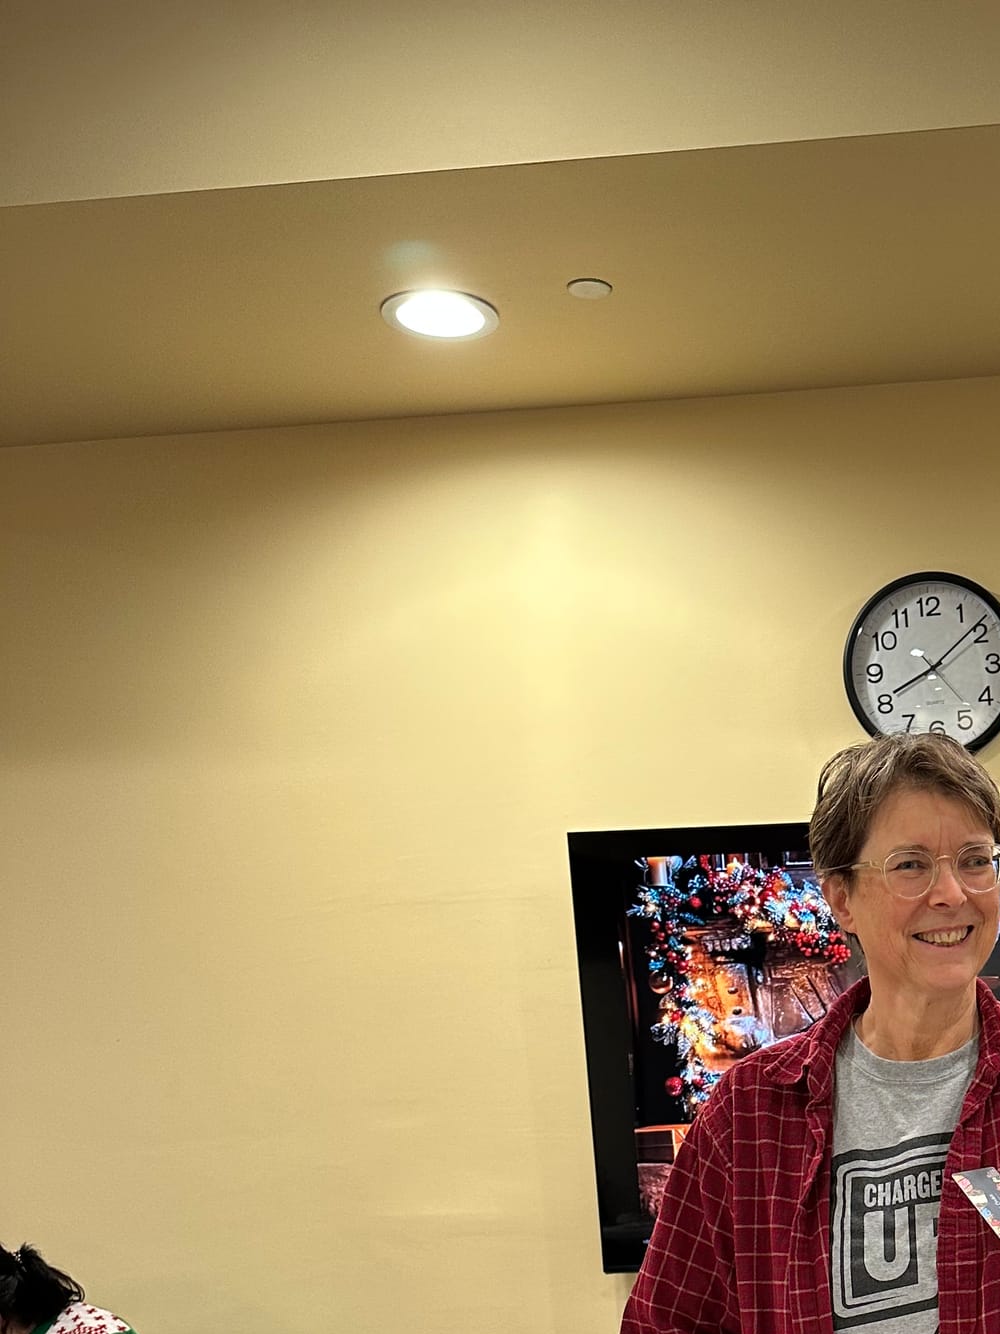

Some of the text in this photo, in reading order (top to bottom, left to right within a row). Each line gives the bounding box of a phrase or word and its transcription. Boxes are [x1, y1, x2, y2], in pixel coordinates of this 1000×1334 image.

[916, 596, 941, 617] 12
[956, 603, 964, 623] 1
[892, 607, 909, 629] 11
[872, 631, 898, 651] 10
[973, 623, 988, 644] 2
[866, 663, 883, 683] 9
[984, 653, 1000, 674] 3
[877, 694, 894, 714] 8
[978, 685, 994, 706] 4
[902, 714, 915, 733] 7
[929, 720, 946, 735] 6
[957, 709, 973, 730] 5
[863, 1171, 944, 1208] CHARGE
